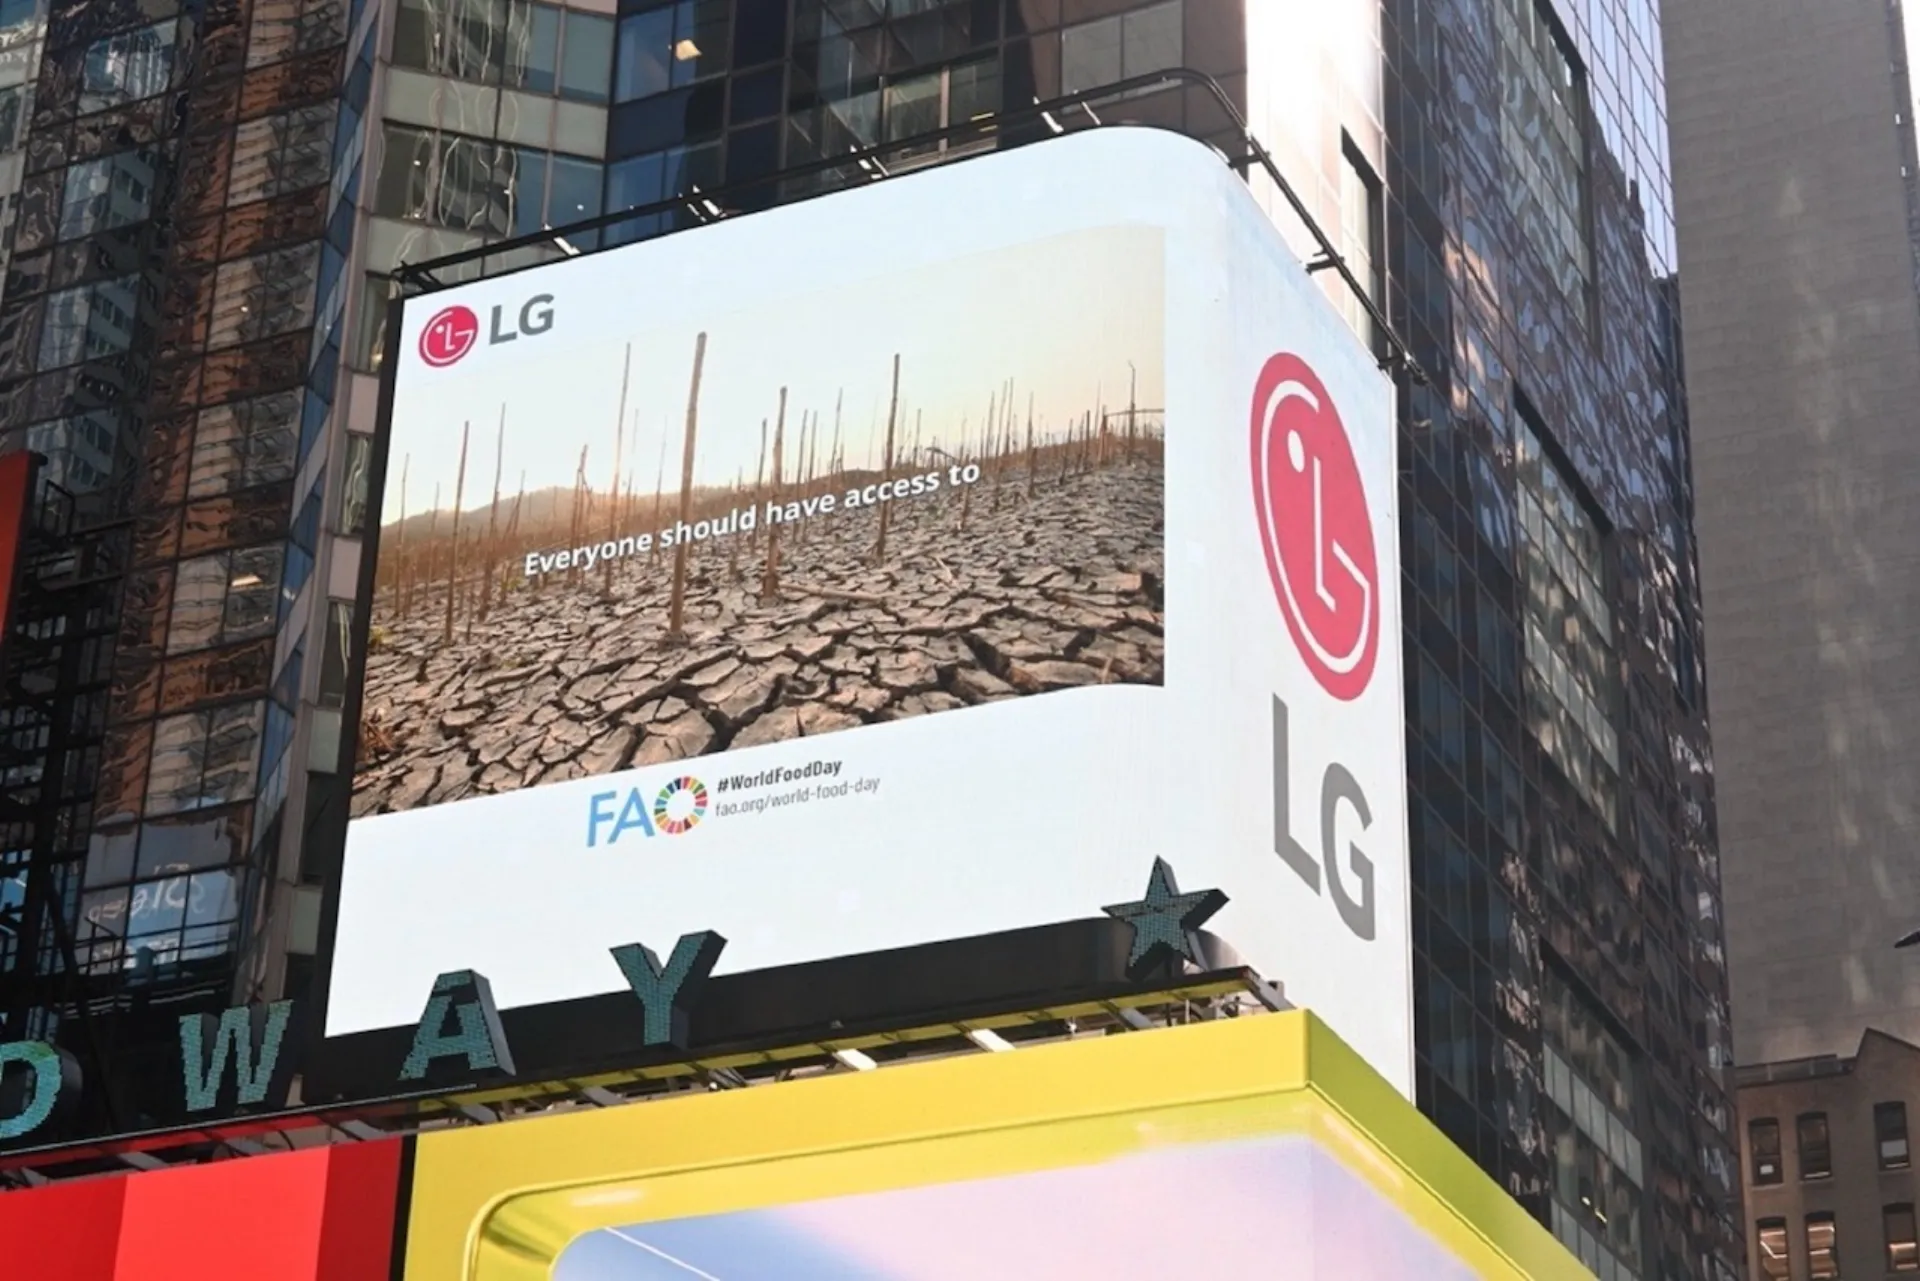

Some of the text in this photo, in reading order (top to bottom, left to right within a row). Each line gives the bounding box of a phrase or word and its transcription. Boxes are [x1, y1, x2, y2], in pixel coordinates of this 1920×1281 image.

[489, 293, 555, 346] LG
[523, 463, 981, 577] Everyone should have access to
[714, 775, 881, 818] fao.org/world-food-day
[716, 760, 843, 794] #WorldFoodDay
[586, 775, 708, 848] FAO
[1272, 691, 1377, 943] LG
